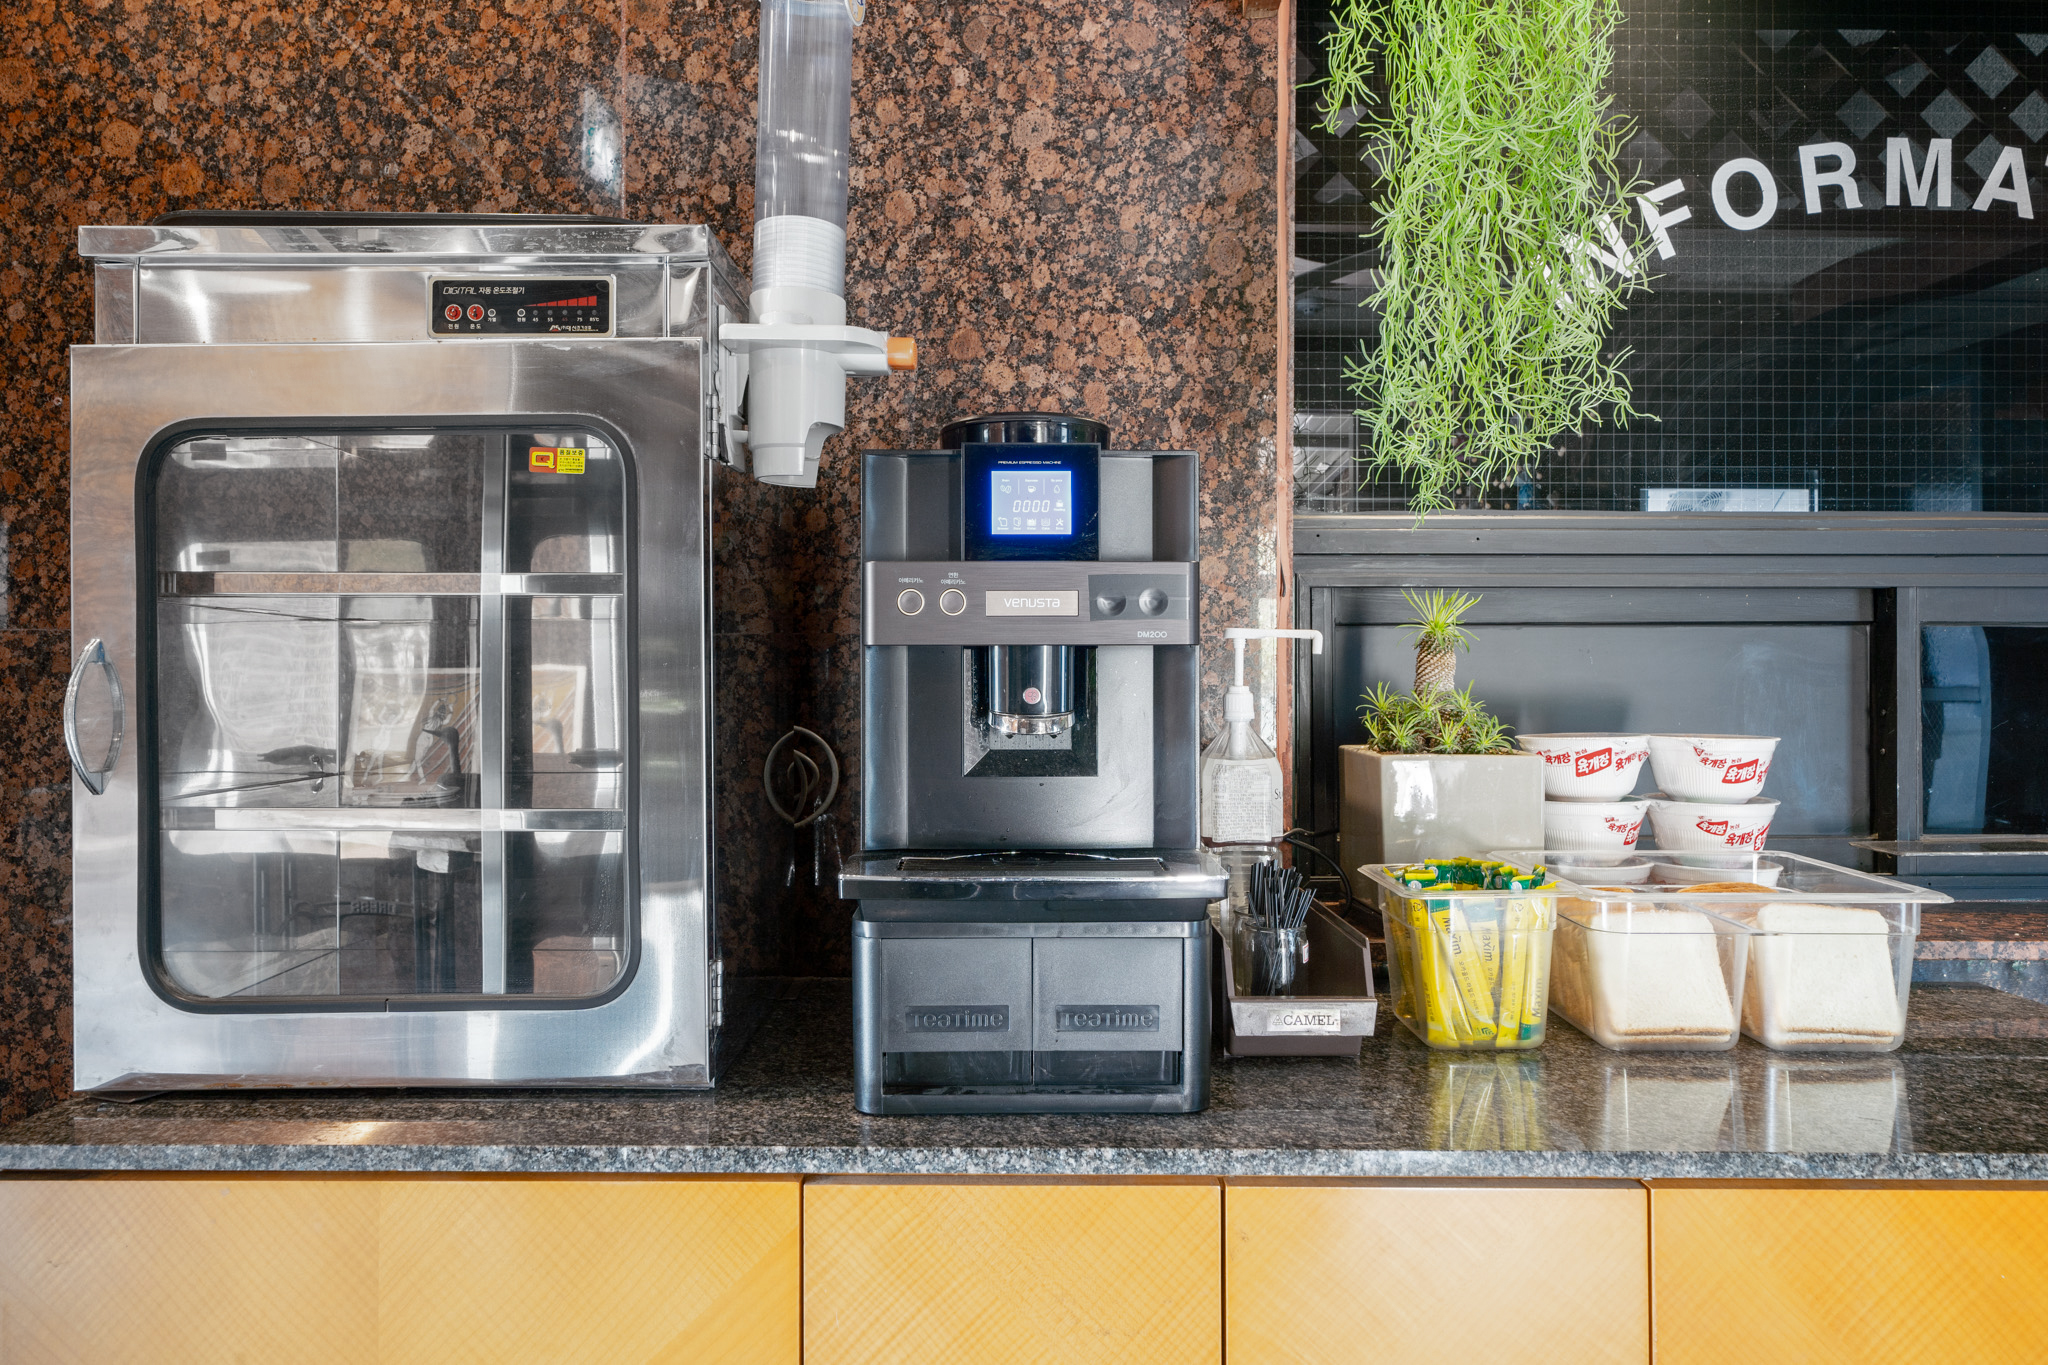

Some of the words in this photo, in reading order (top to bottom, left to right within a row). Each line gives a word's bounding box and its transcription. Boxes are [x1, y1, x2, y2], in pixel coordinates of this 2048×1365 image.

[1529, 137, 2048, 316] NFORMA
[1013, 500, 1050, 512] 0000
[1545, 752, 1571, 765] 육개장
[1577, 752, 1610, 774] 육개장
[1700, 757, 1727, 769] 육개장
[1725, 763, 1756, 782] 육개장
[1725, 829, 1754, 846] 육개장
[1283, 1014, 1335, 1026] CAMEL
